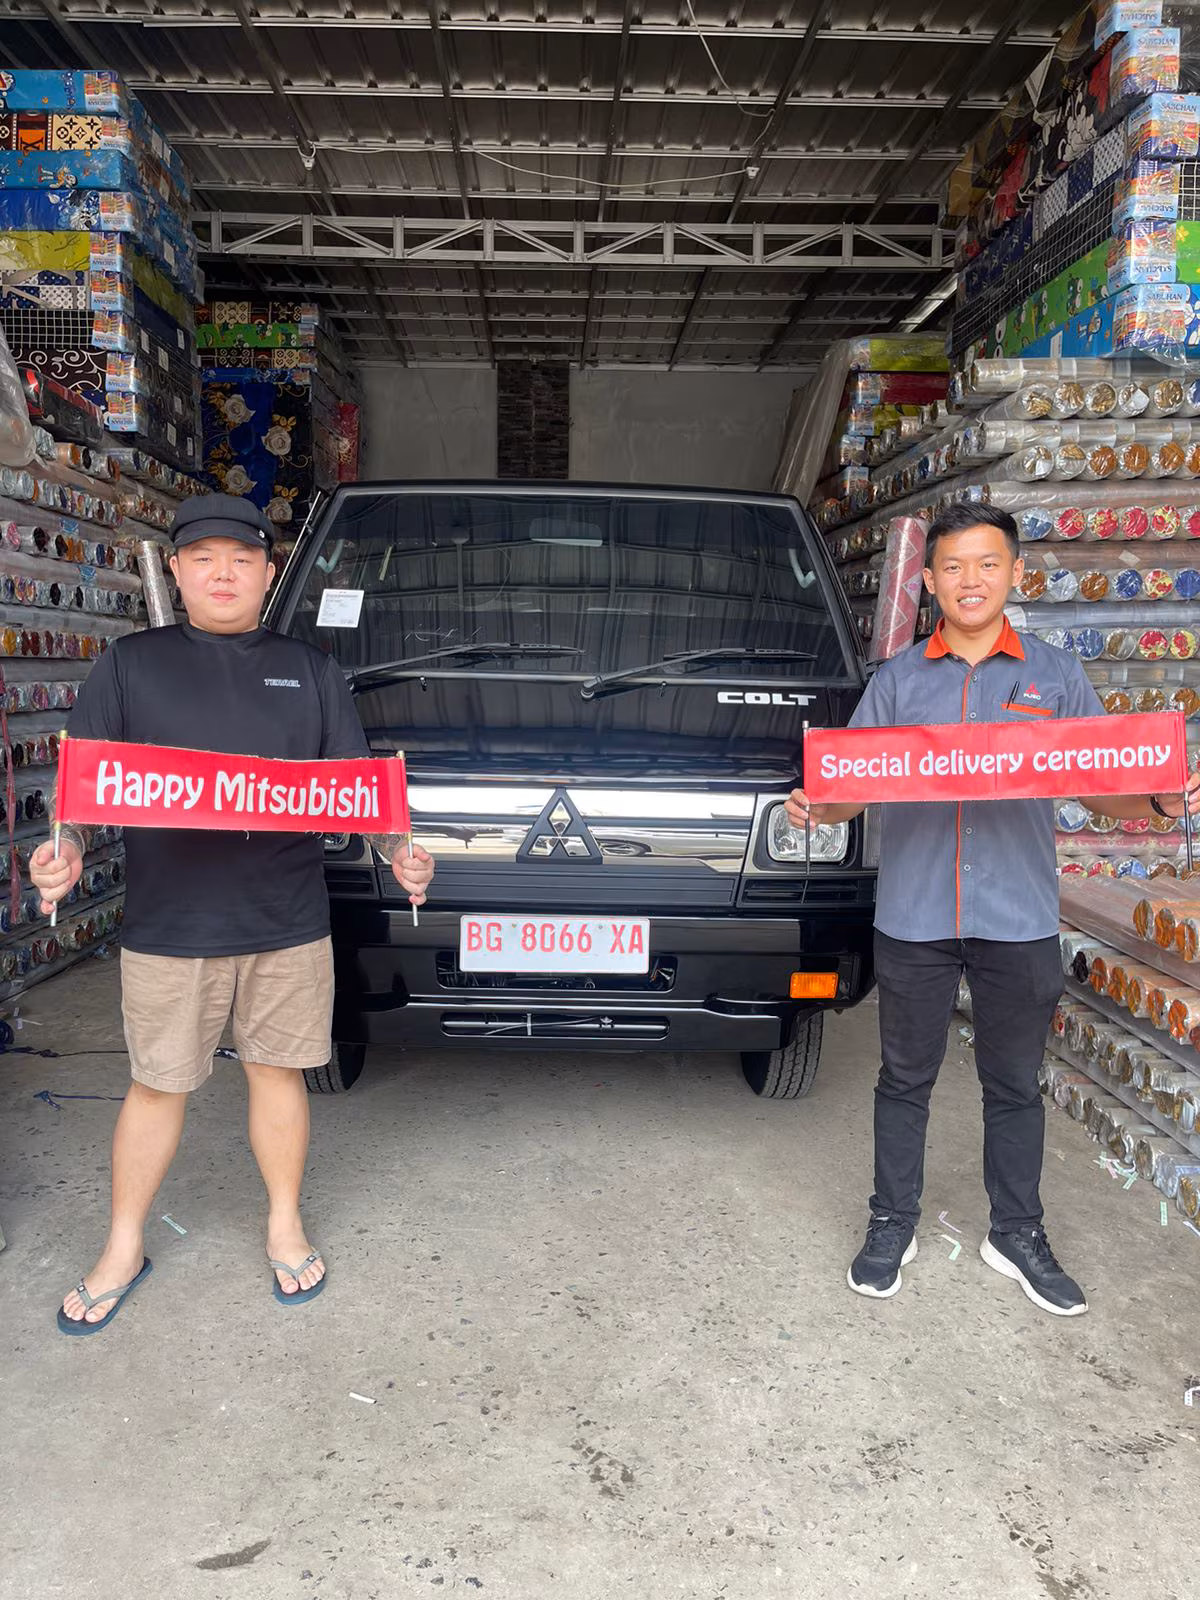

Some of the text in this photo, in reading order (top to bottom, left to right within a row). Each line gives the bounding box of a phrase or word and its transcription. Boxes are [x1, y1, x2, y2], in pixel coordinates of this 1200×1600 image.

[716, 691, 817, 706] COLT
[820, 743, 1172, 779] Special delivery ceremony
[95, 759, 380, 819] Happy Mitsubishi
[465, 920, 645, 955] BG 8066 XA
